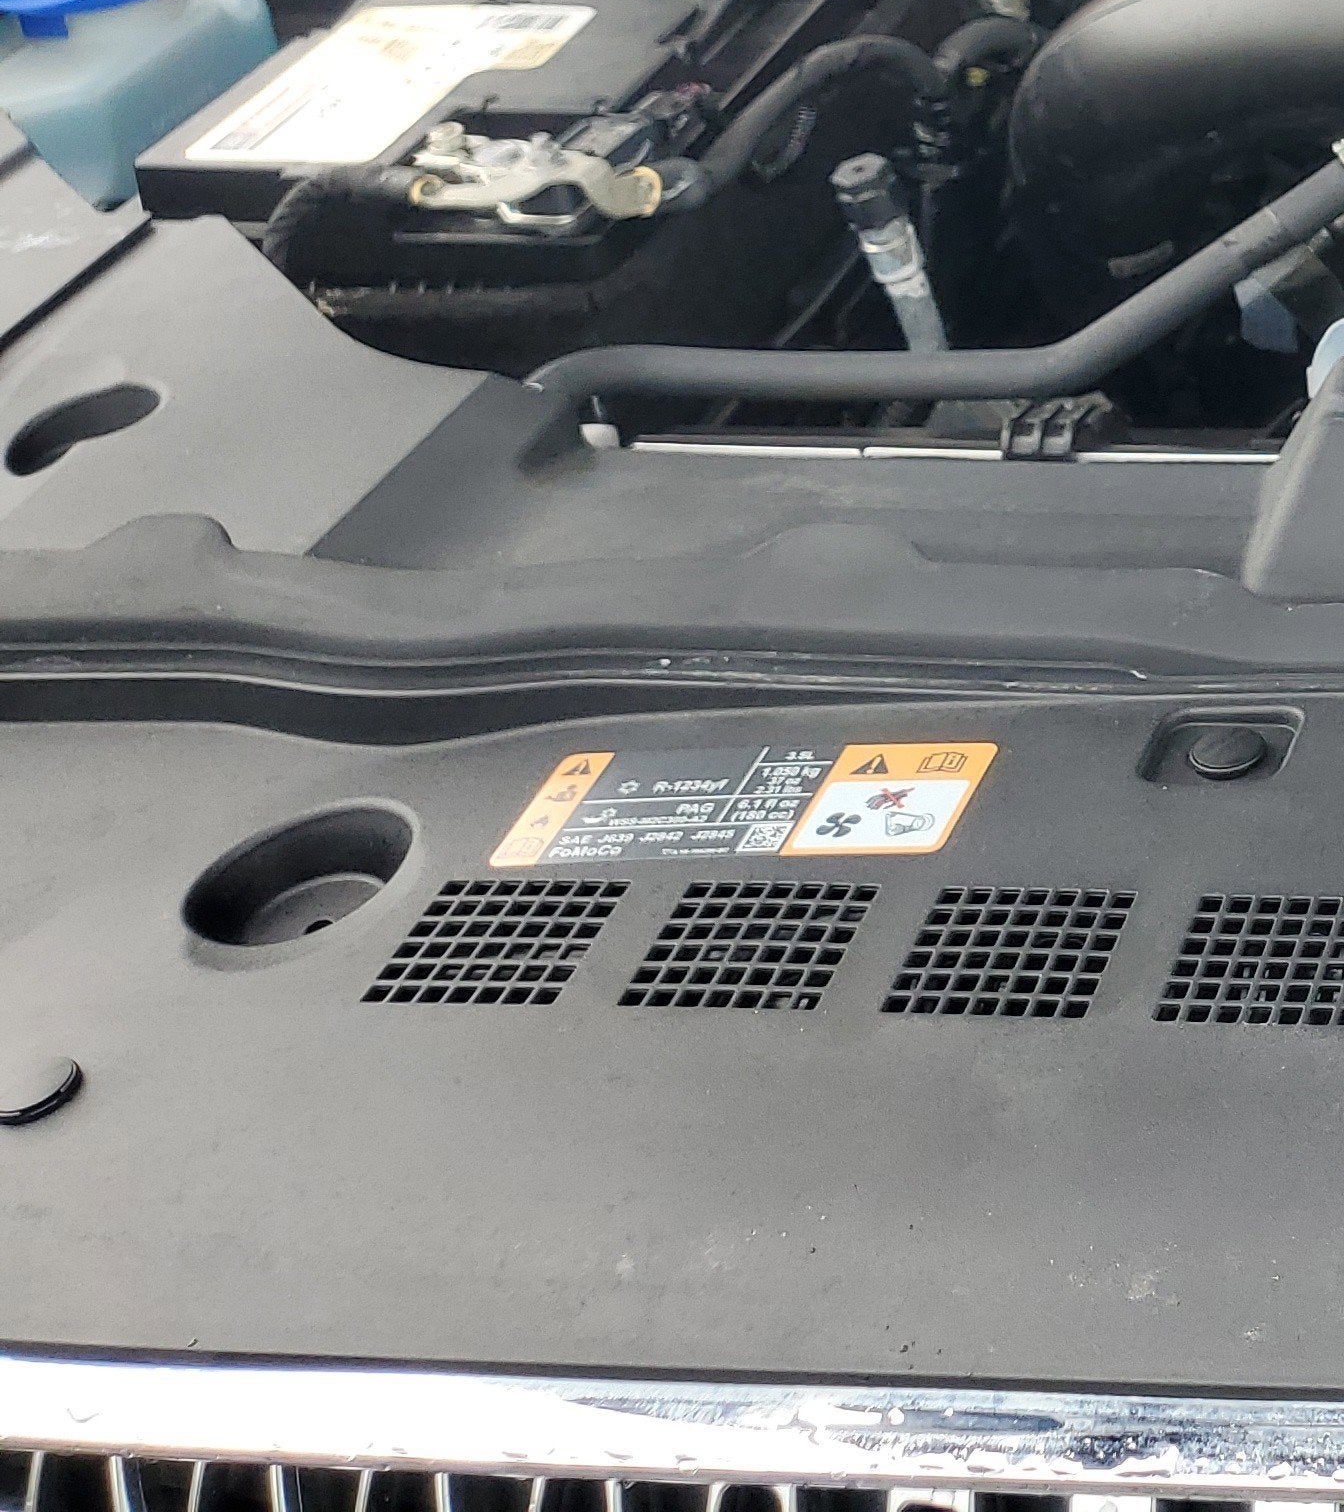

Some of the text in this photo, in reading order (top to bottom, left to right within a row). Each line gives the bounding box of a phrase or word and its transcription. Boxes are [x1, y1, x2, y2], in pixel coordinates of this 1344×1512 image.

[801, 765, 823, 779] kg
[675, 802, 716, 817] PAG
[558, 834, 593, 846] SAE
[548, 844, 623, 859] FoMoCo
